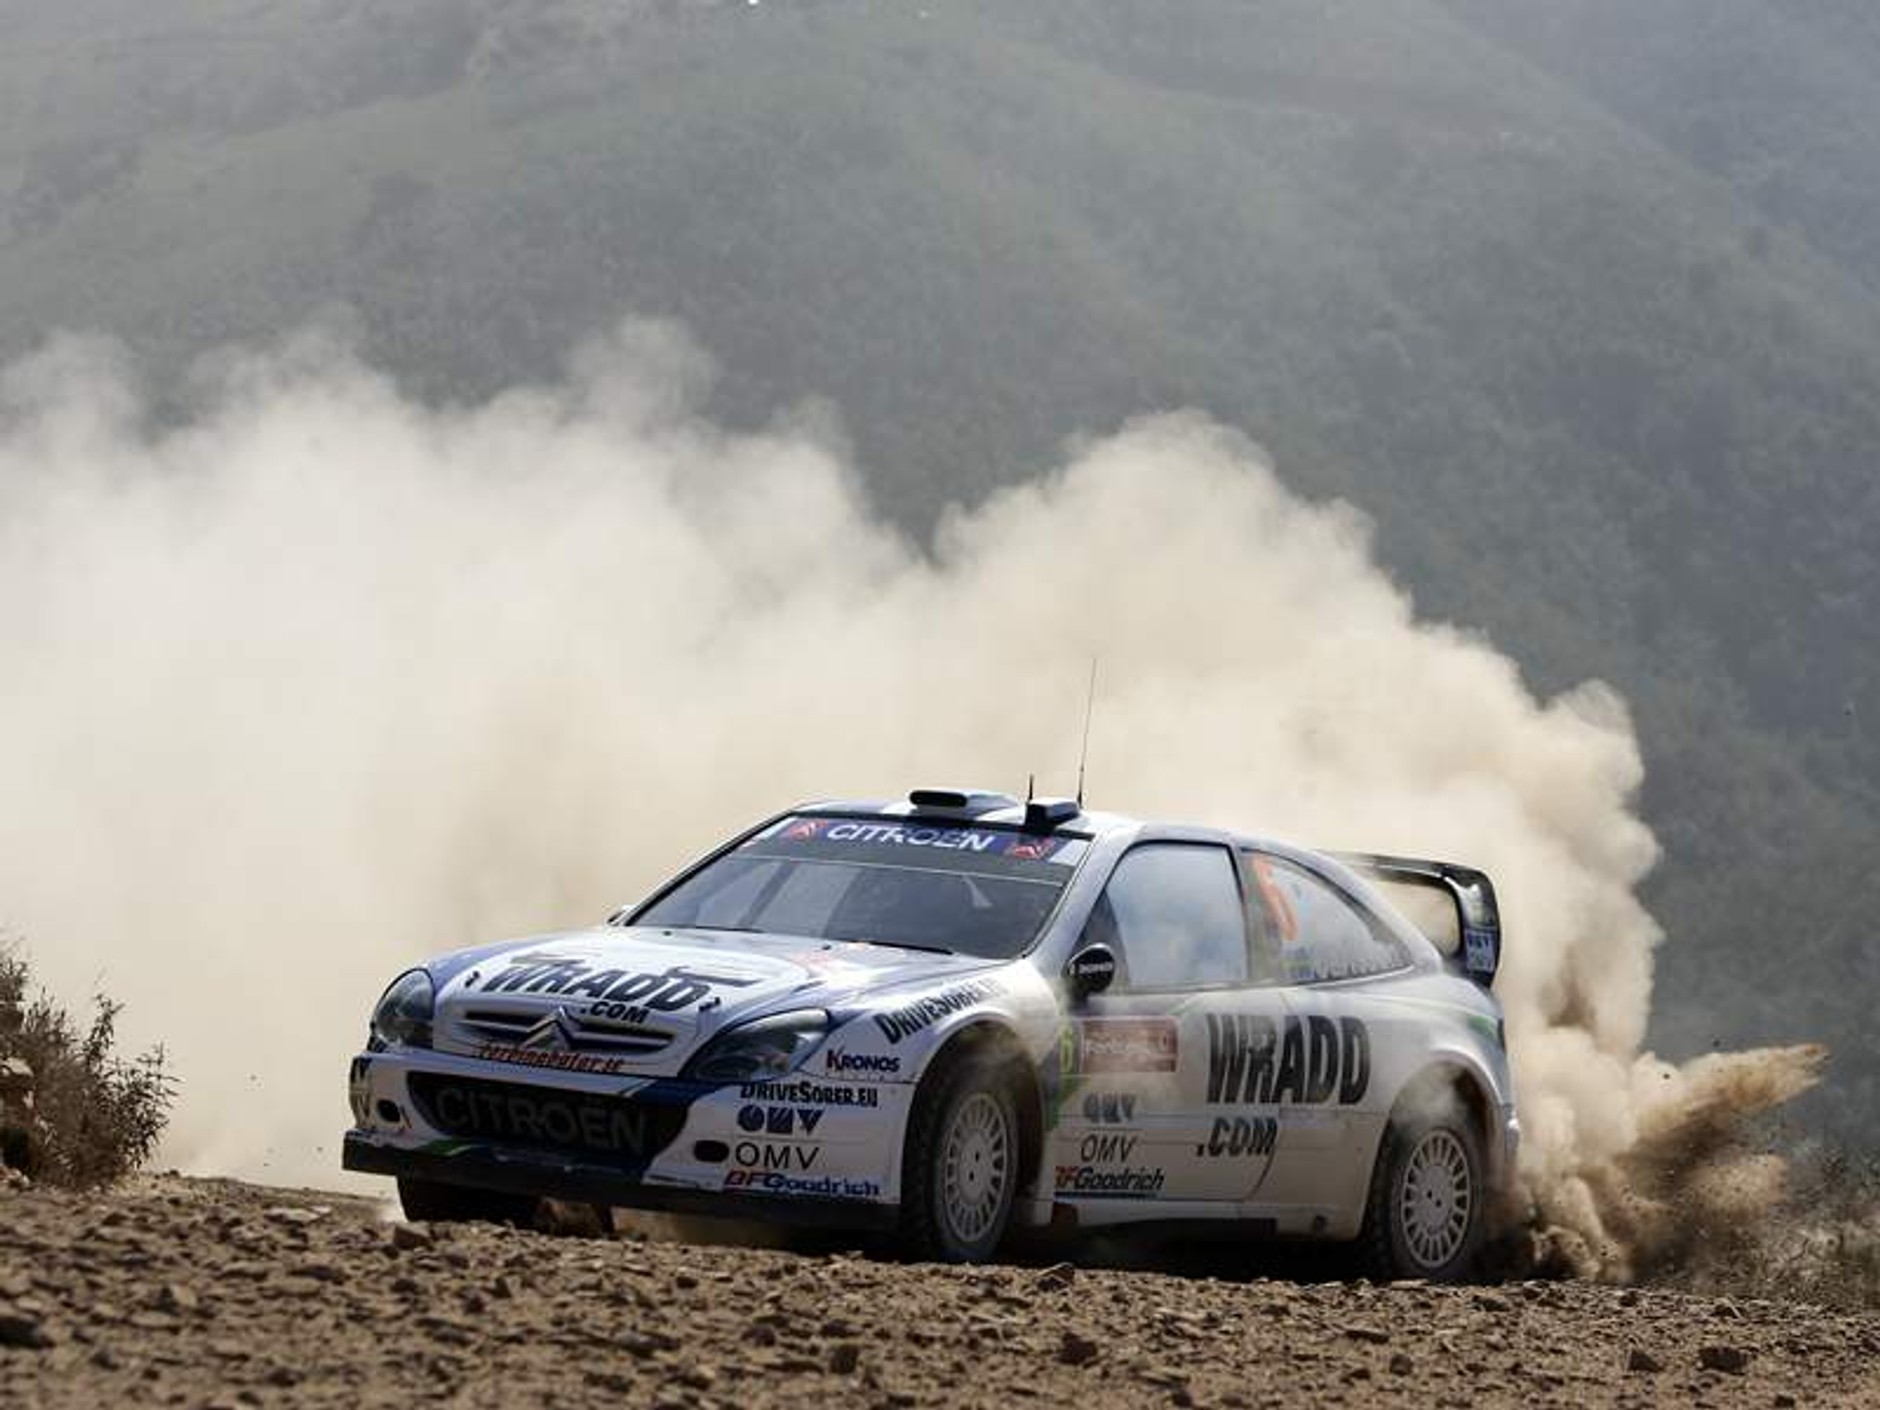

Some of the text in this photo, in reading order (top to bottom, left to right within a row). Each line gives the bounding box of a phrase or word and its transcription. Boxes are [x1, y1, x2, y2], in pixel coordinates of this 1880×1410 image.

[1081, 1133, 1138, 1162] OMV
[1196, 1117, 1278, 1157] .COM
[735, 1142, 820, 1170] OMV
[723, 1169, 880, 1195] BFGoodrich
